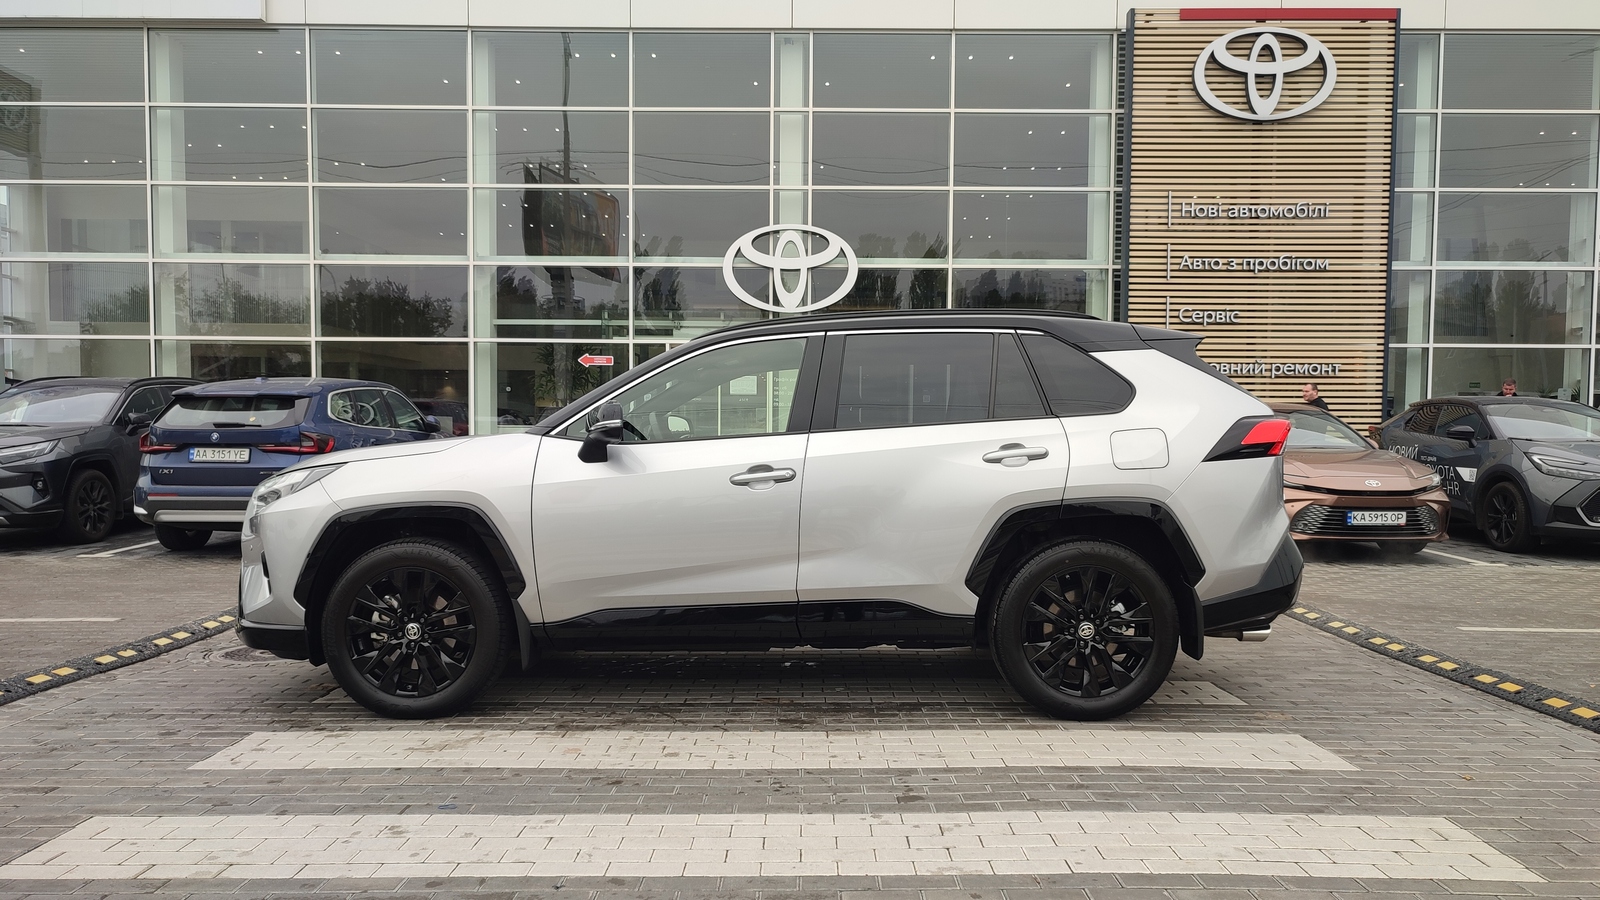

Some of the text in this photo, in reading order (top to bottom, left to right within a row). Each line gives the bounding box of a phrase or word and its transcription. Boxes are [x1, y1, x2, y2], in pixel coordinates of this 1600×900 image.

[1181, 201, 1330, 218] Нові автомобілі
[1179, 254, 1329, 274] Авто з пробігом
[1178, 307, 1240, 326] Сервіс
[1209, 359, 1342, 379] овний ремонт
[195, 449, 246, 459] AA 3151 YE
[1388, 443, 1419, 460] НОВИЙ
[1422, 463, 1456, 480] OYOTA
[1442, 481, 1461, 496] -HR
[1352, 513, 1404, 522] KA 5915 OP
[401, 548, 450, 565] ALENZA
